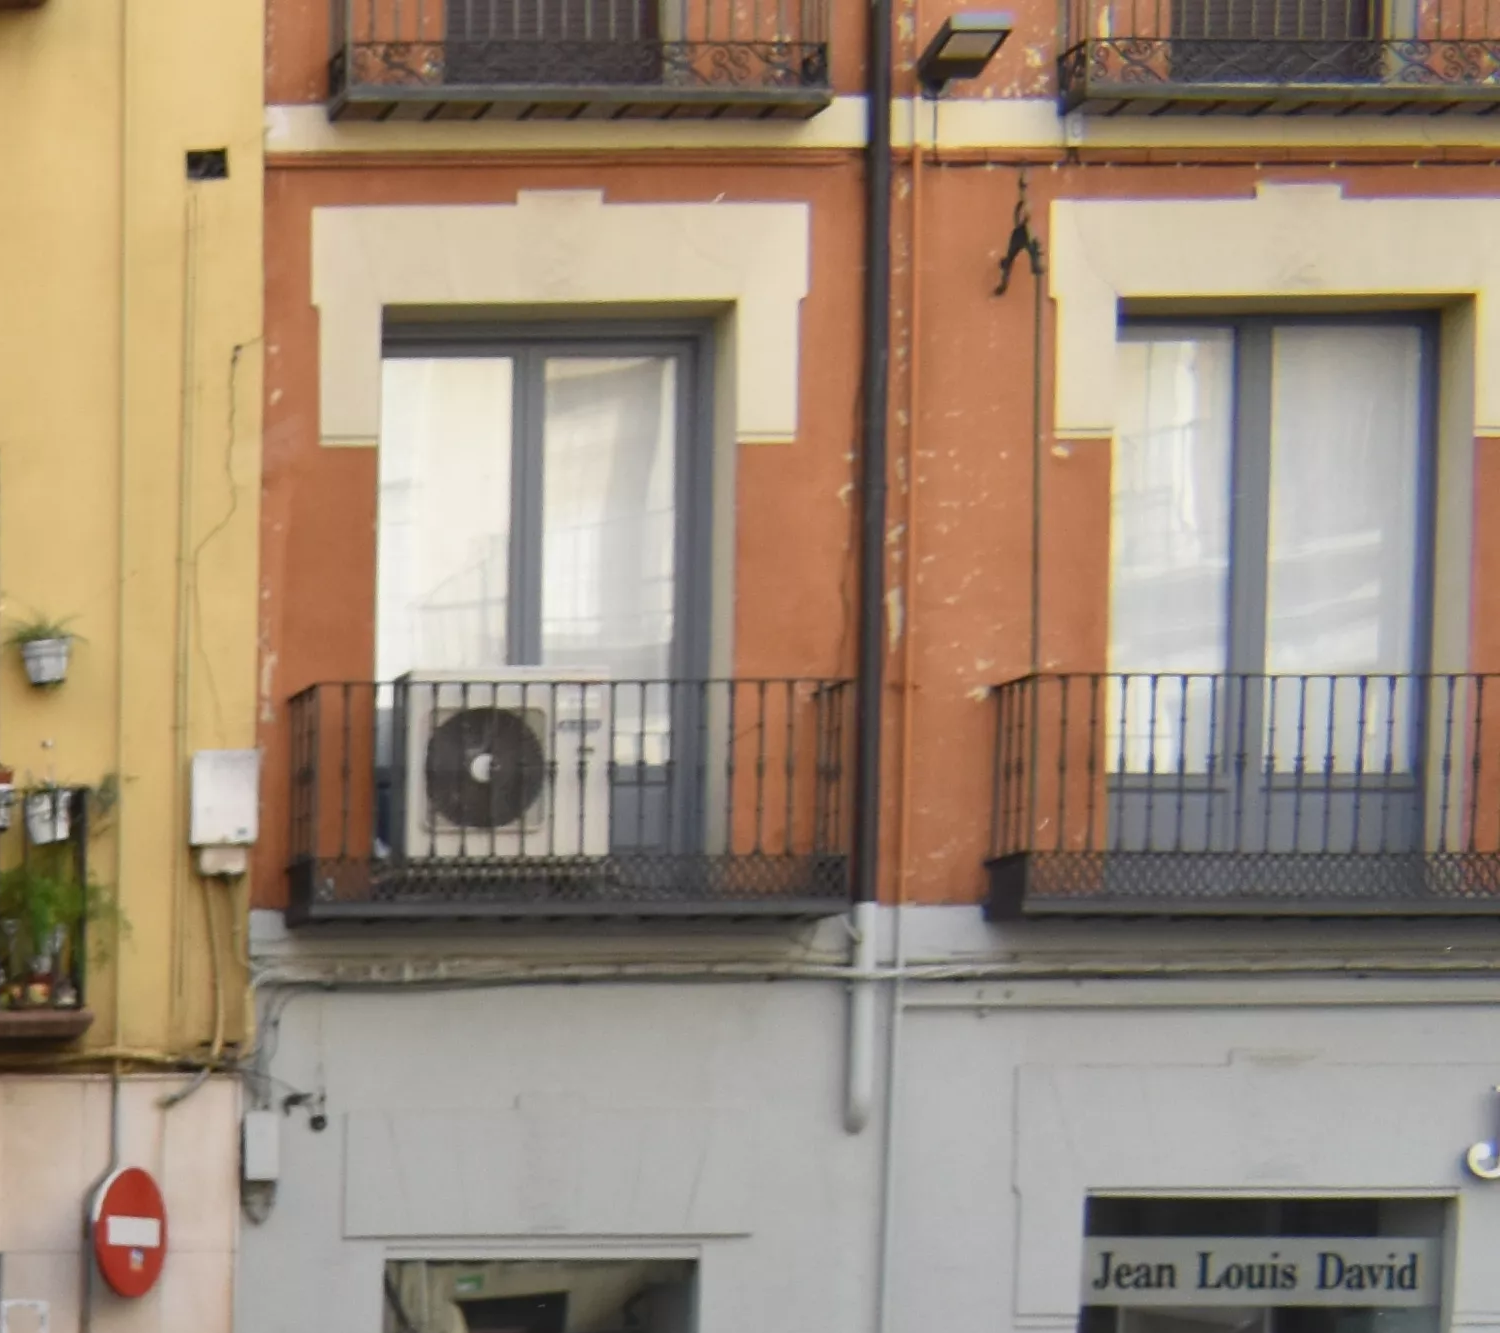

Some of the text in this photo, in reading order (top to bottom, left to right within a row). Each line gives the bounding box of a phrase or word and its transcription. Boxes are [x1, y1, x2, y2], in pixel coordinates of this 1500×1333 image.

[1092, 1251, 1419, 1292] Jean Louis David
